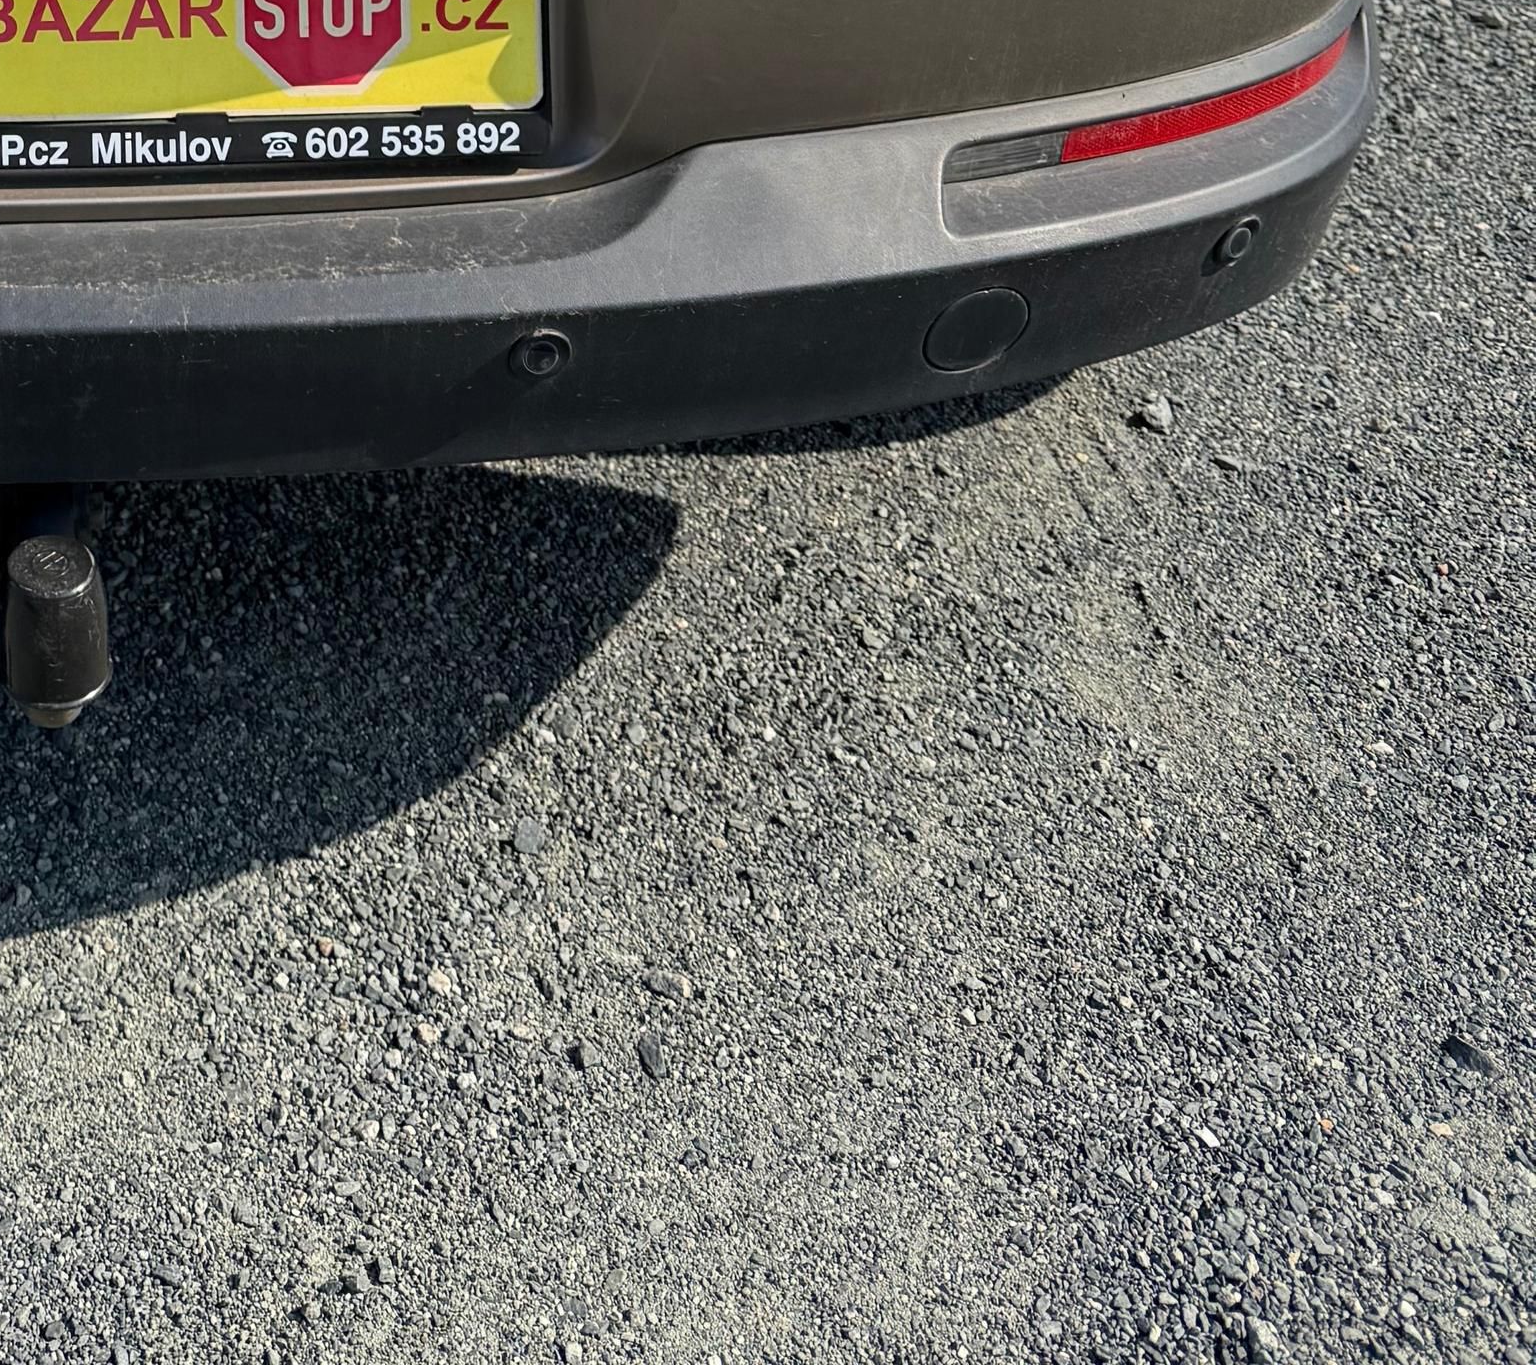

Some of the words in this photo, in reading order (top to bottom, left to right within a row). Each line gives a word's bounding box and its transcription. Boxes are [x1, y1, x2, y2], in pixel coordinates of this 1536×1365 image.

[91, 131, 233, 165] Mikulov
[305, 126, 369, 159] 602
[381, 124, 445, 157] 535
[456, 121, 521, 153] 892
